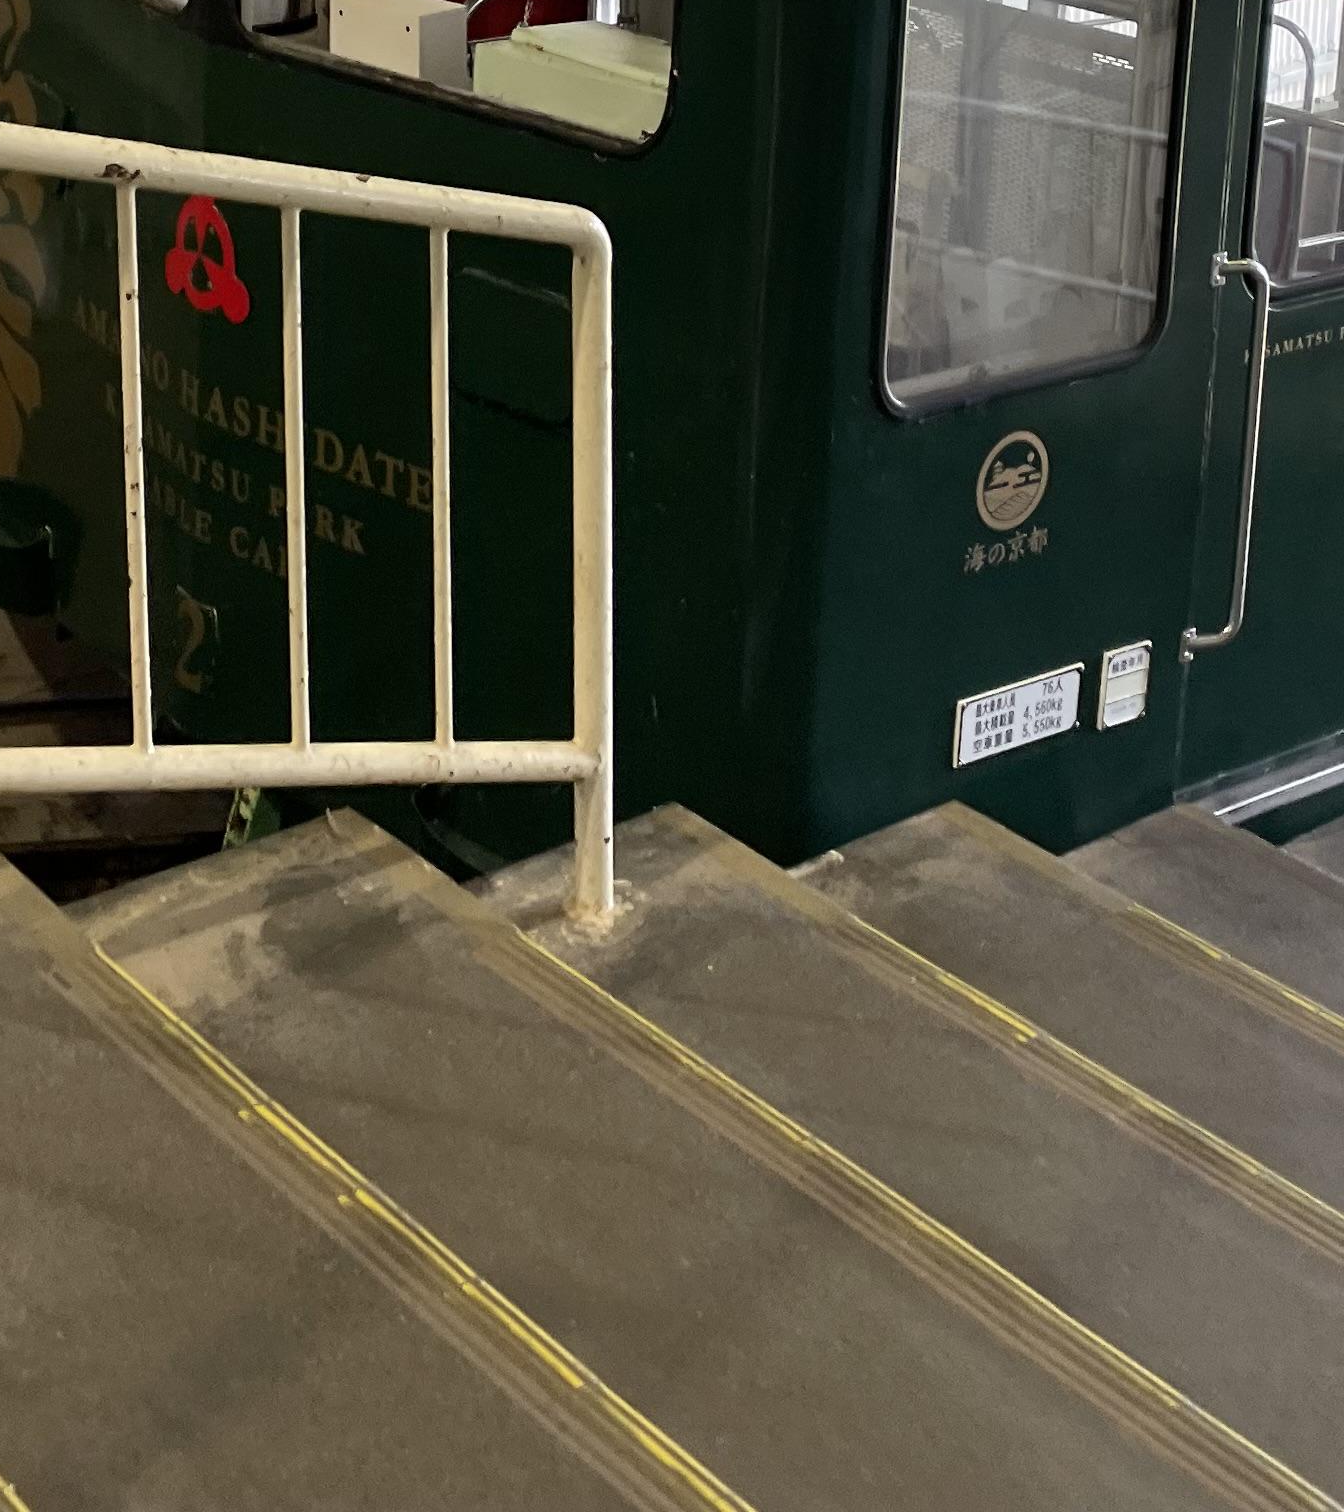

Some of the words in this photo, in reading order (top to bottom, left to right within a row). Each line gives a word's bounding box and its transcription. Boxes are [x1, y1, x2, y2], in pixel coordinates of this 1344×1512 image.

[181, 368, 432, 514] HASHDATE
[269, 486, 366, 556] PRK
[964, 526, 1049, 573] 海の京都
[229, 526, 286, 579] CA
